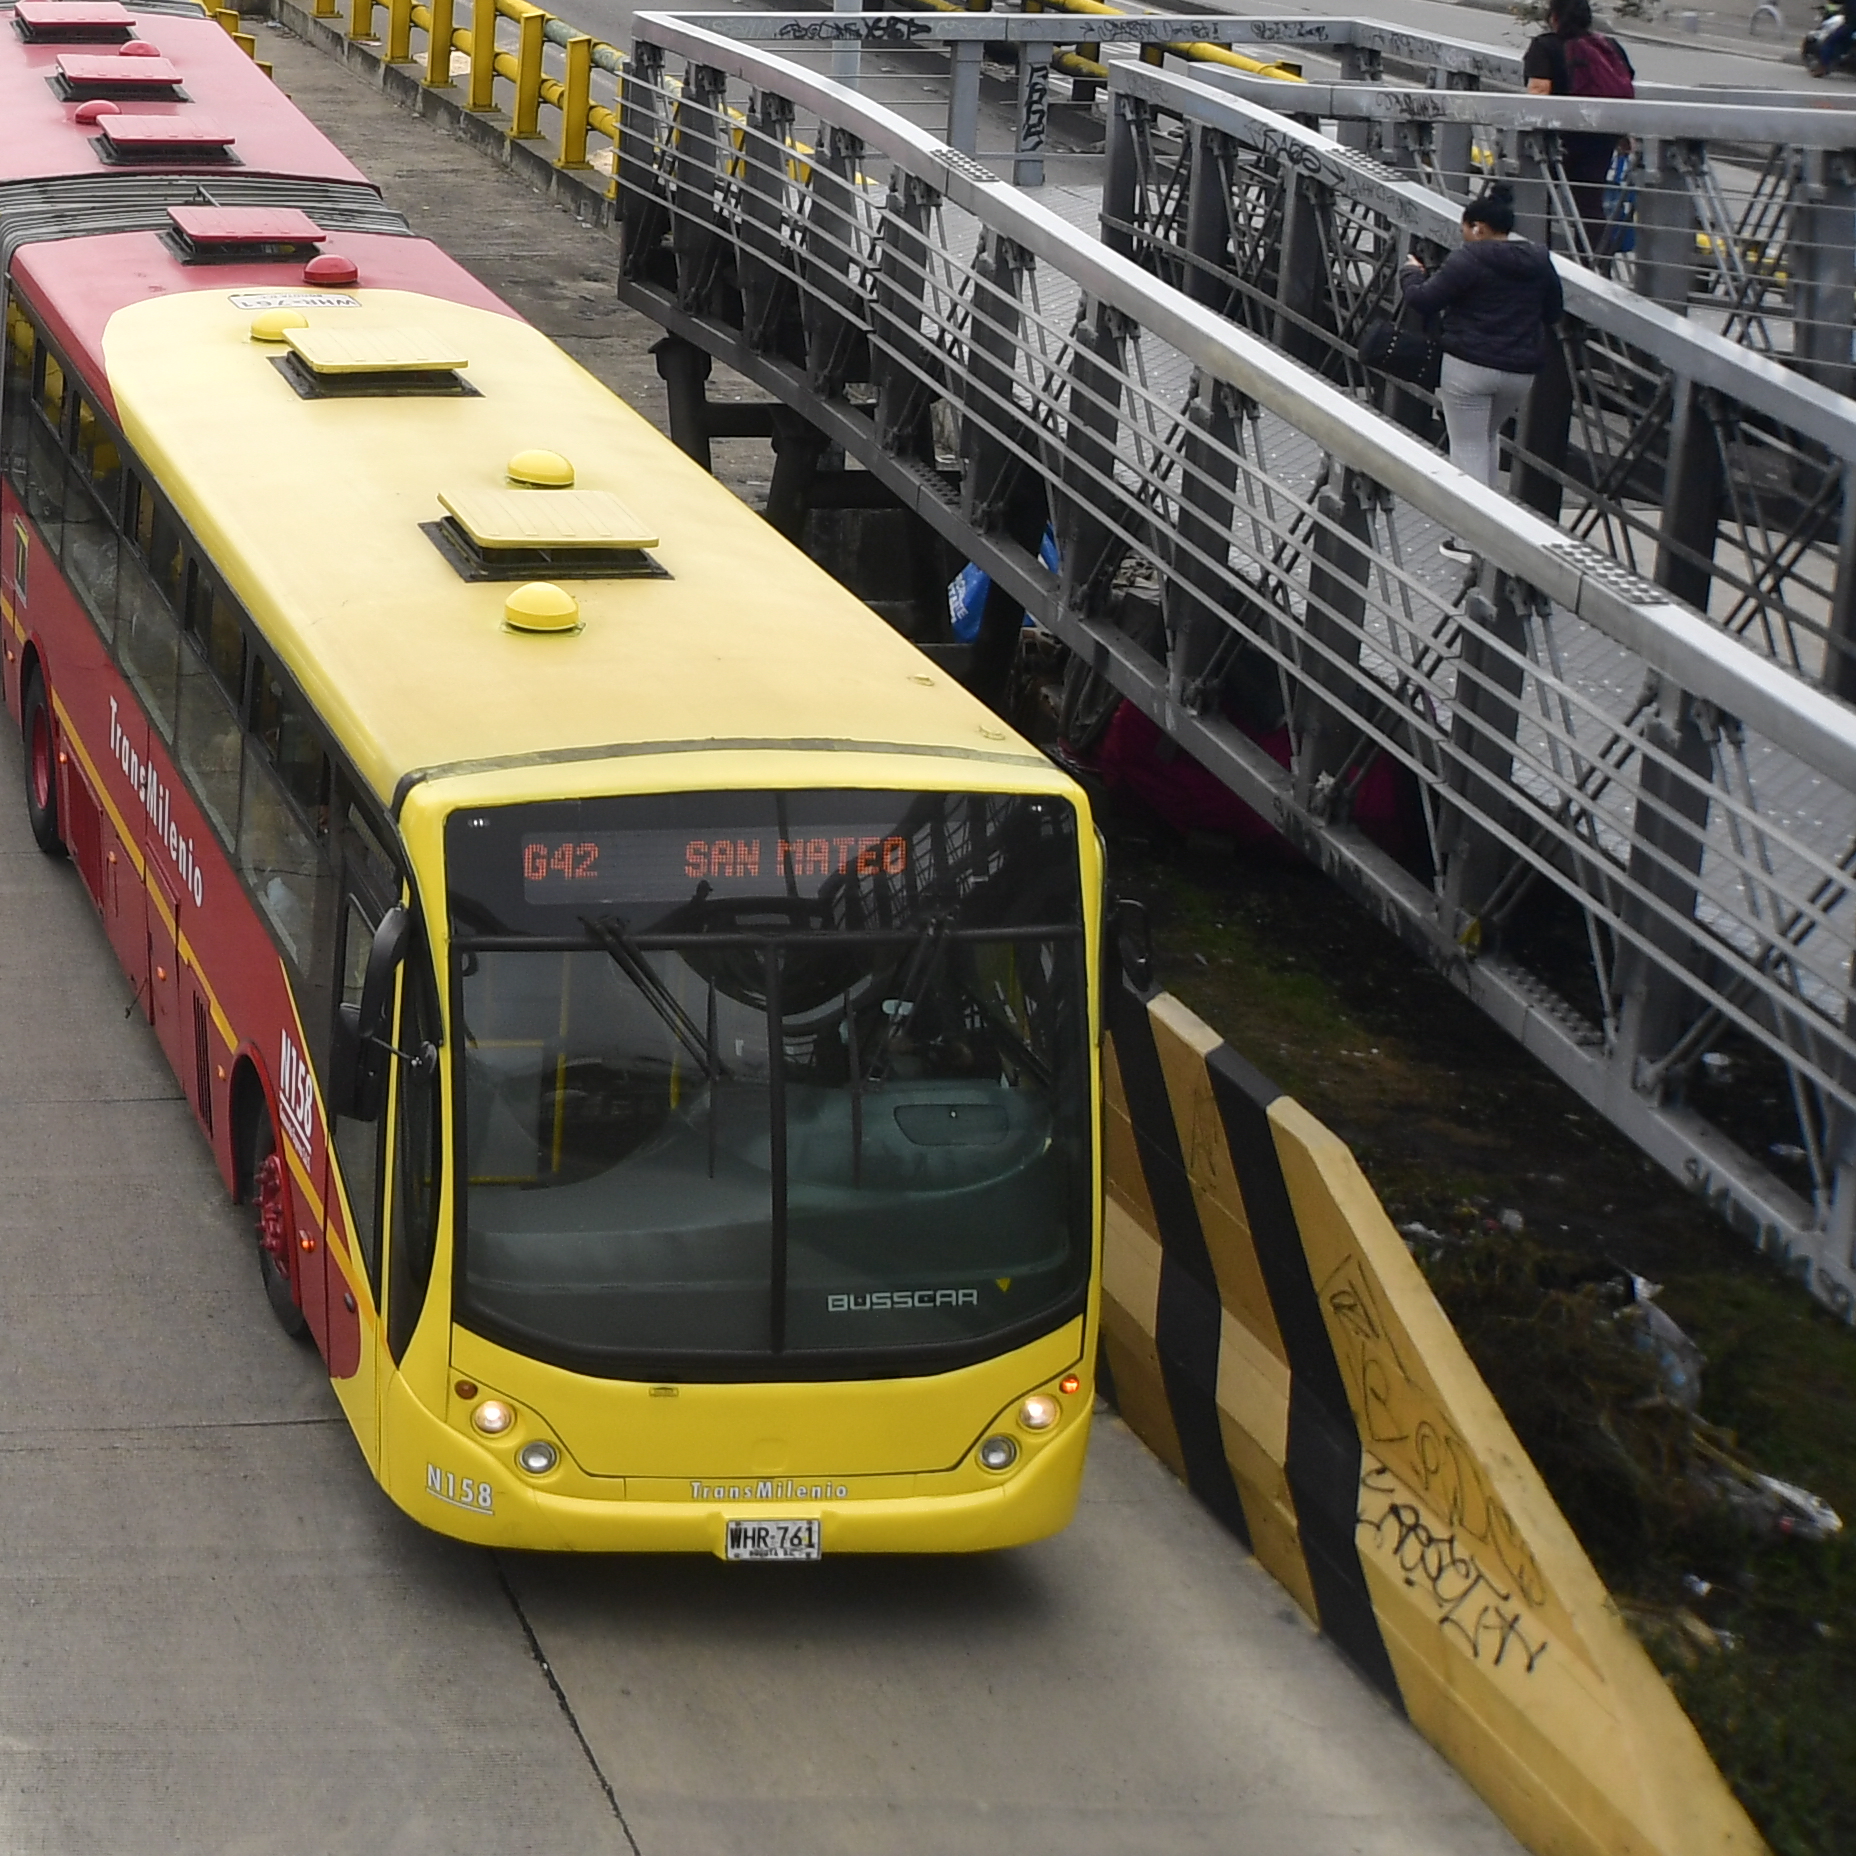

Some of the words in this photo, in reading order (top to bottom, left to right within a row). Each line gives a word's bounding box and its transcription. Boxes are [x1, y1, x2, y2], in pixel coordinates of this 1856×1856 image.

[109, 695, 203, 907] TransMilenio
[524, 842, 600, 881] G42
[685, 839, 760, 878] SAN
[777, 836, 908, 876] MATEO
[280, 1028, 313, 1138] N158
[828, 1289, 978, 1312] BUSSCAR
[428, 1463, 492, 1507] N158
[691, 1480, 848, 1499] TransMilenio
